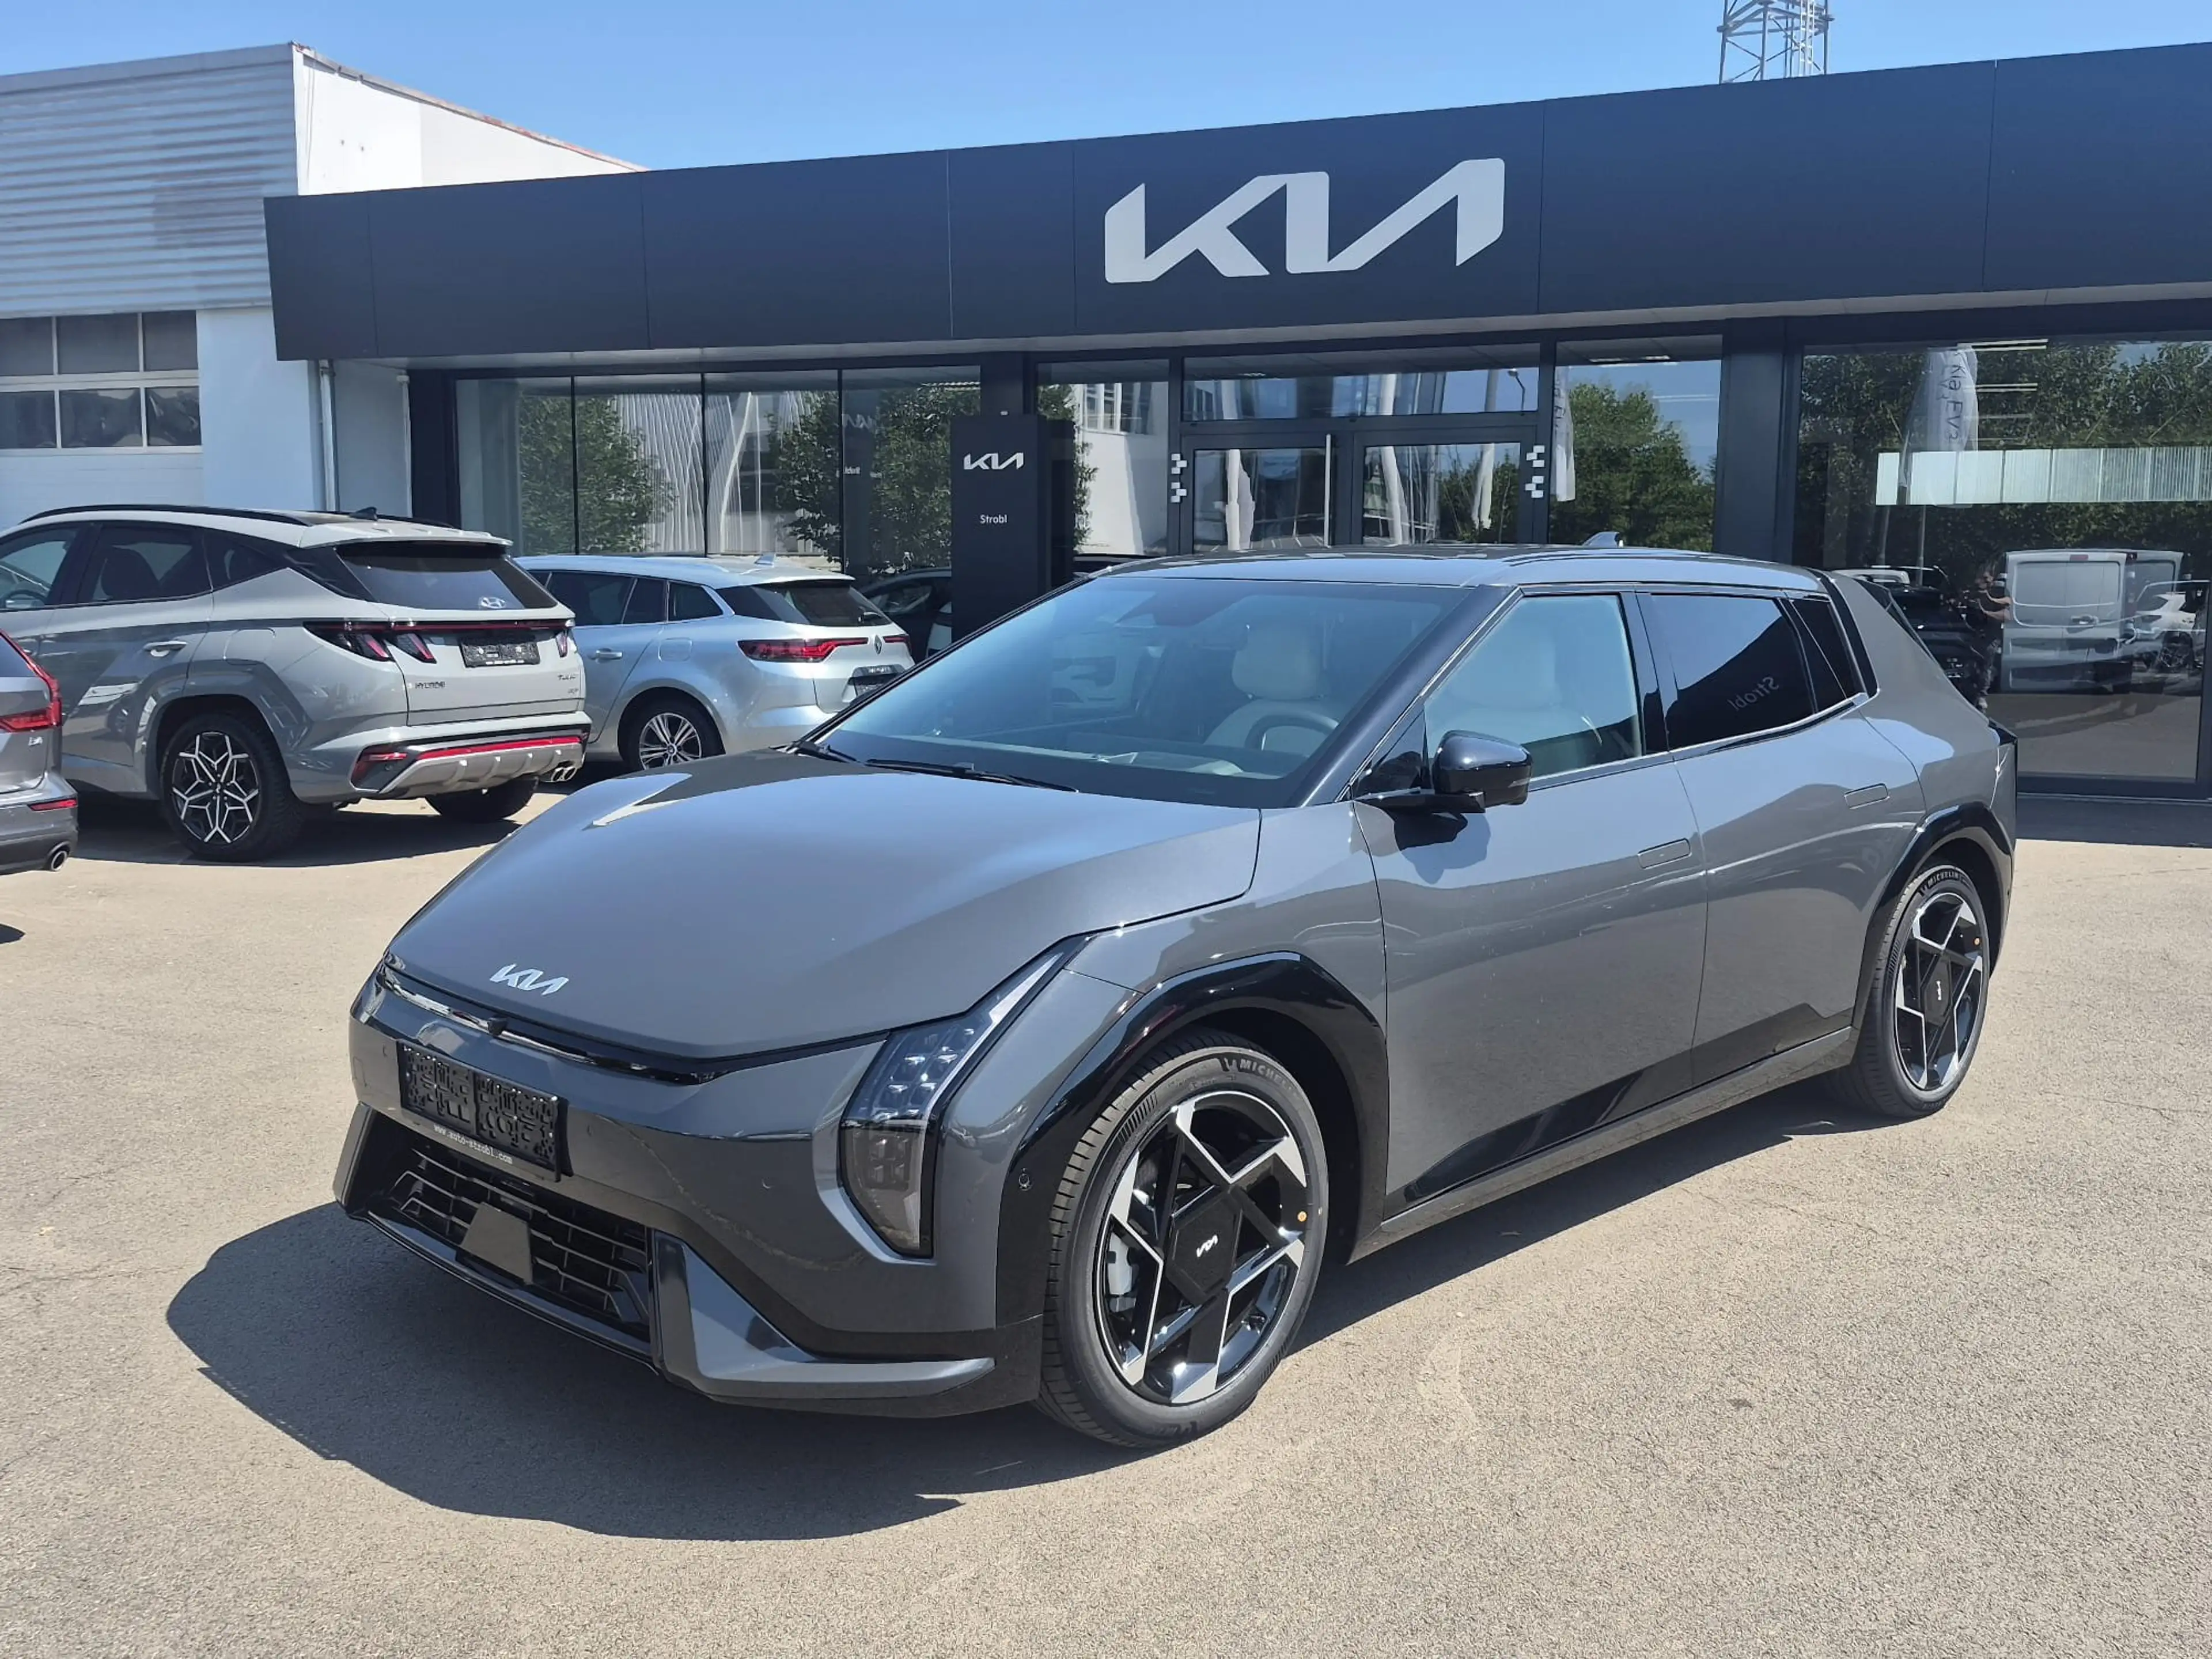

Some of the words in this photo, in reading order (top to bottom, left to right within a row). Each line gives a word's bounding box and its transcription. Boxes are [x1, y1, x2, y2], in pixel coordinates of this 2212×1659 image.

[1105, 158, 1505, 283] KIA
[963, 452, 1024, 470] KIA
[980, 514, 1008, 524] Strobl
[490, 963, 569, 995] KIA
